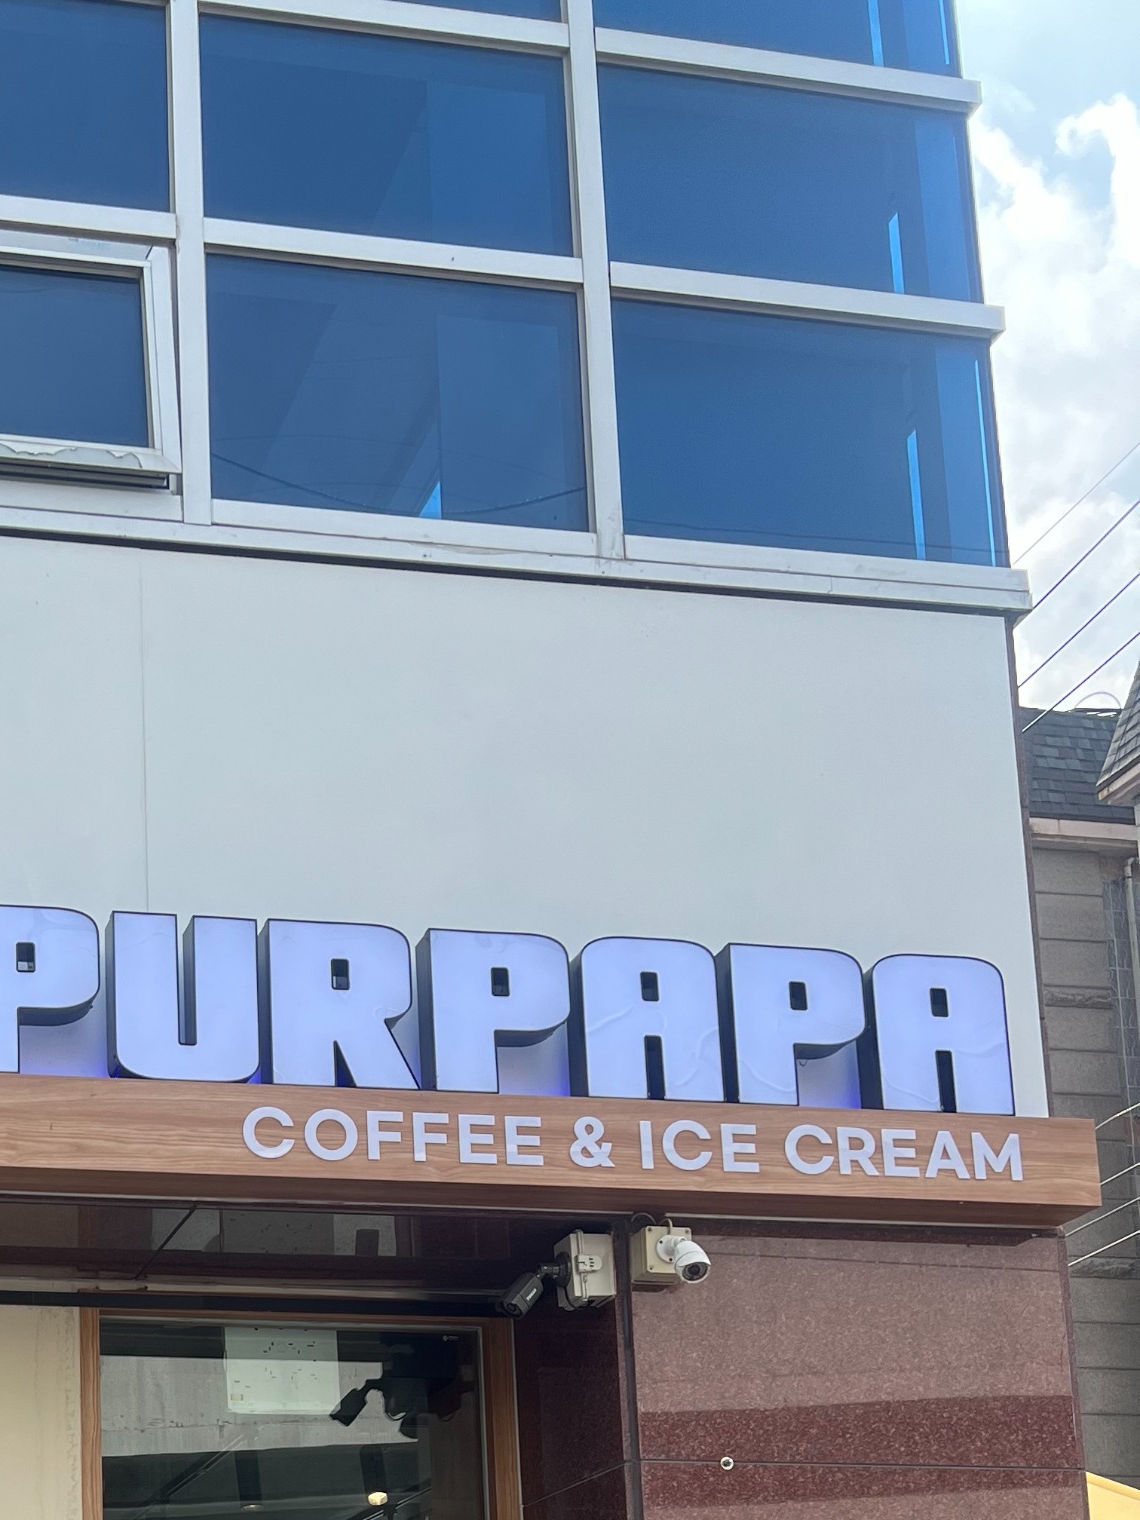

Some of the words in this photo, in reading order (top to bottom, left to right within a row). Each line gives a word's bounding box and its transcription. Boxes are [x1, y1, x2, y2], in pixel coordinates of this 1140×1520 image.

[243, 1106, 544, 1167] COFFEE
[570, 1116, 615, 1169] &
[641, 1119, 759, 1174] ICE
[785, 1123, 1024, 1182] CREAM
